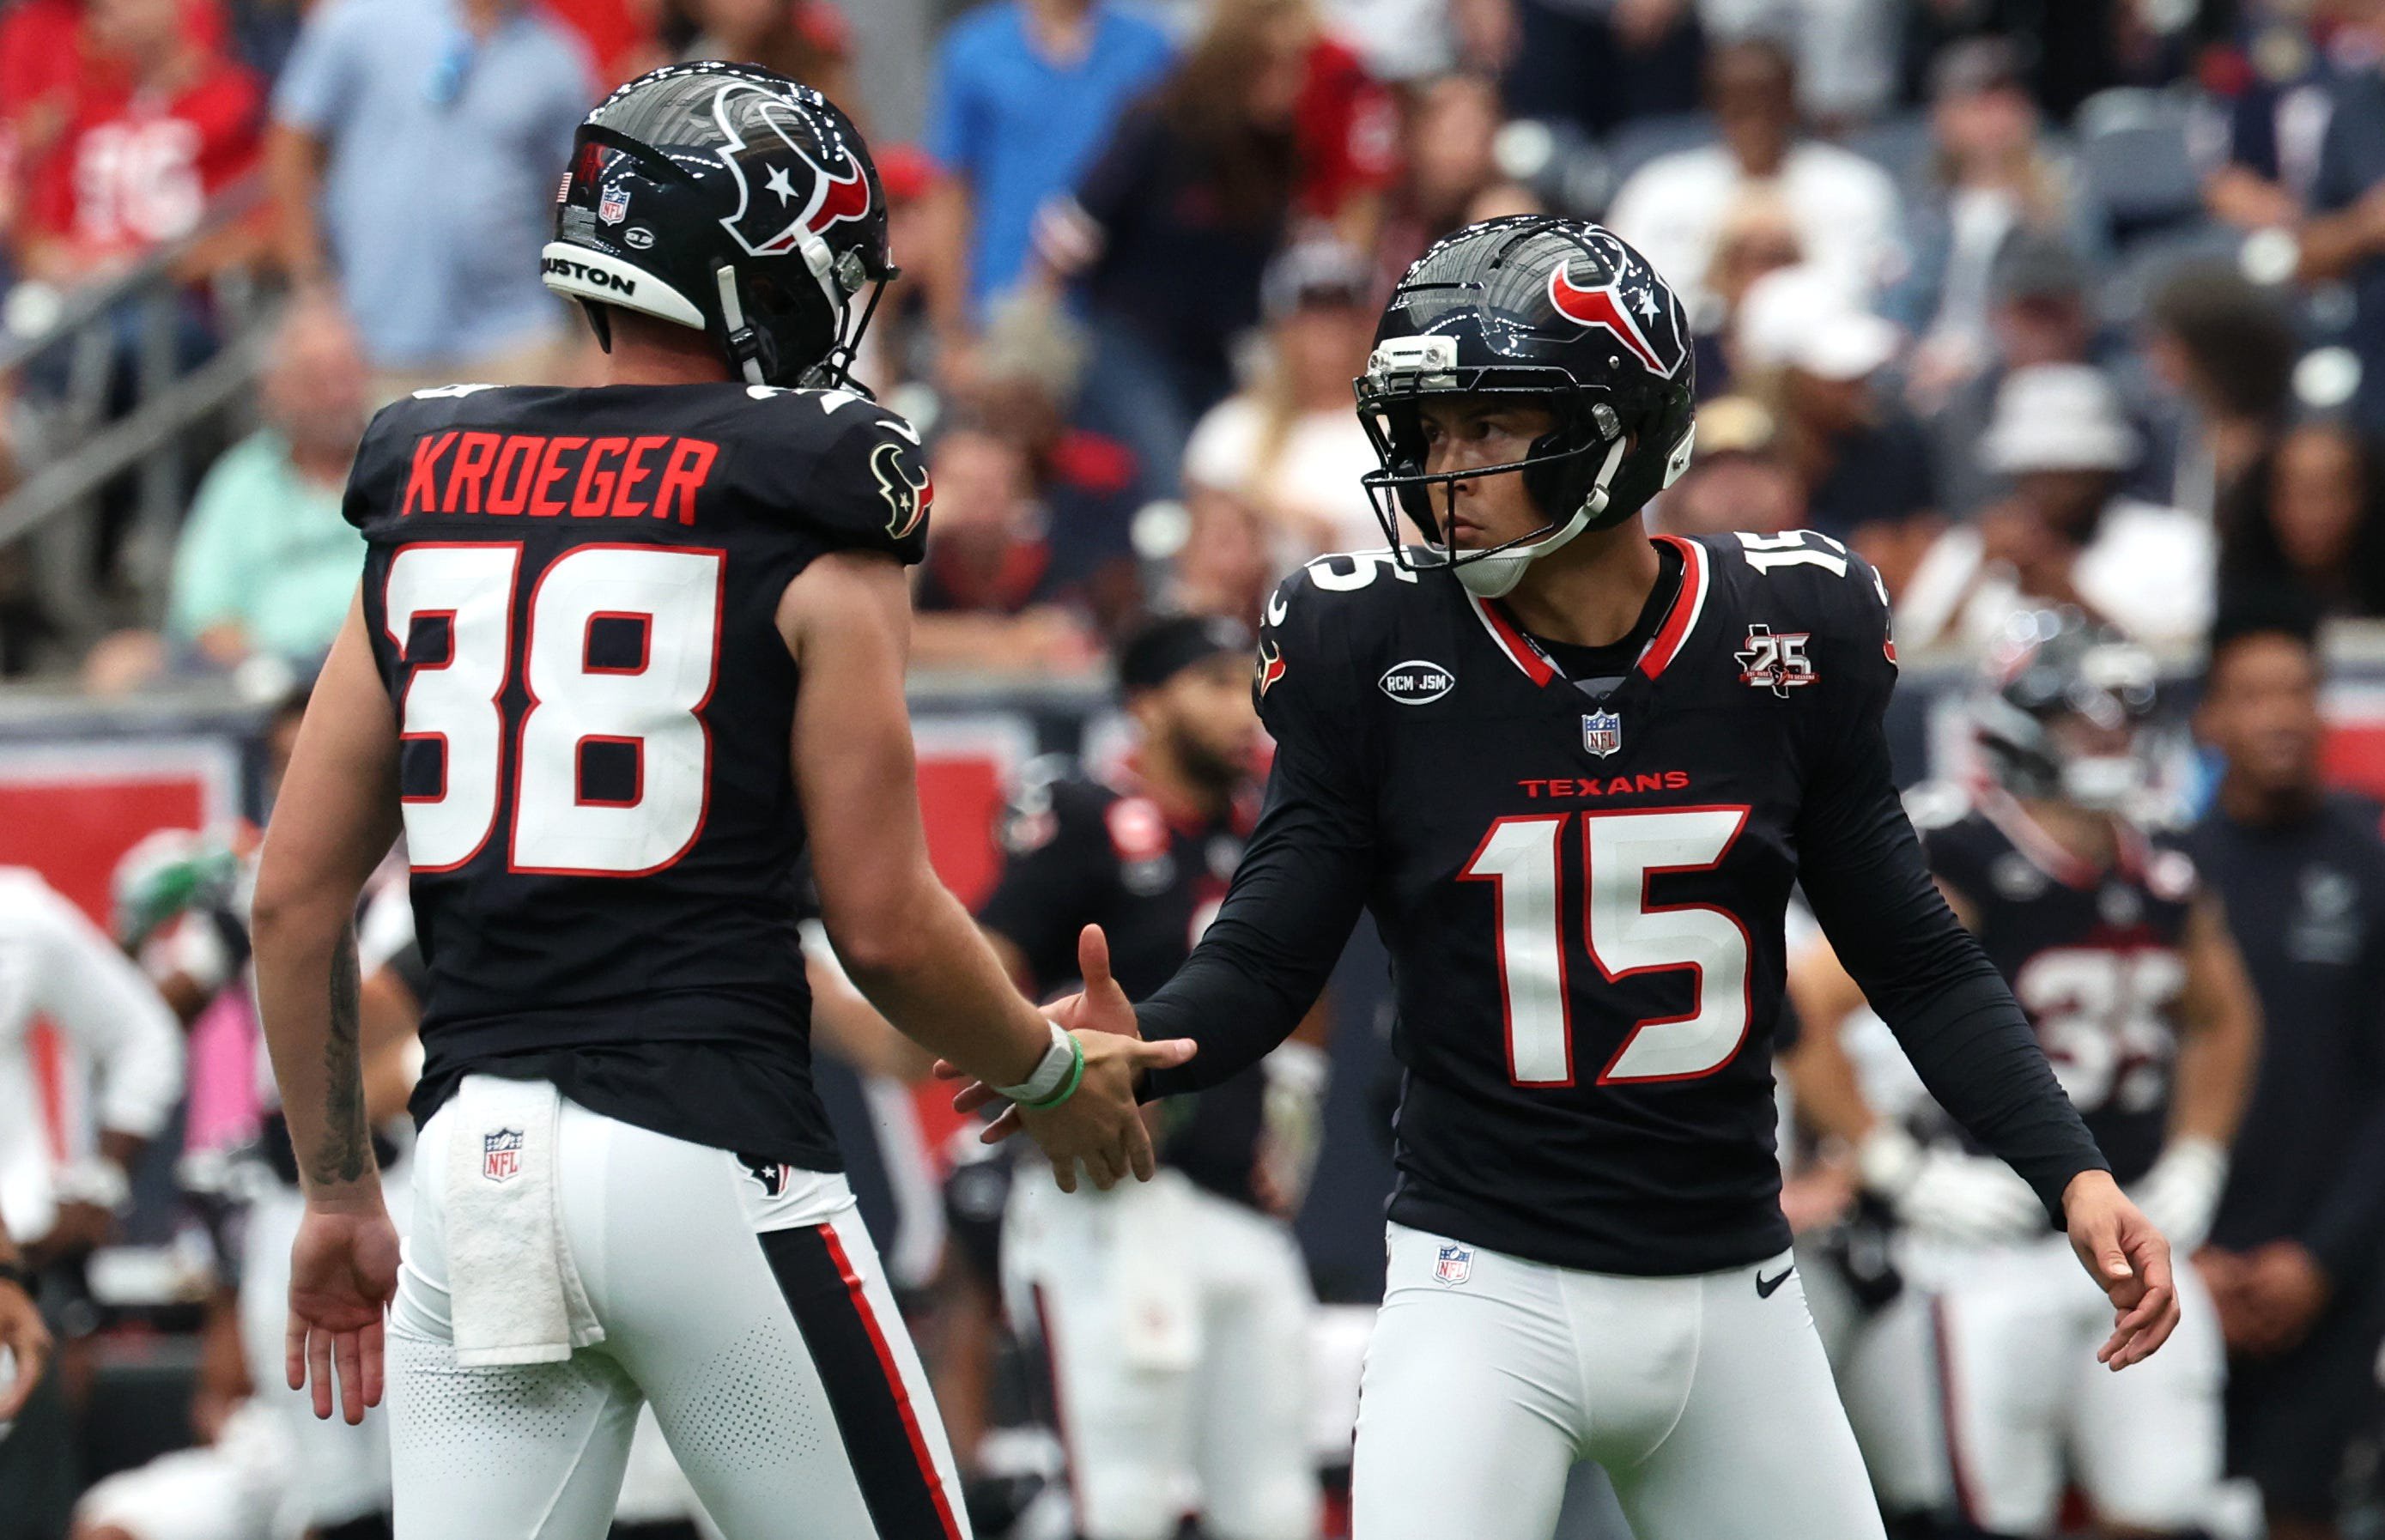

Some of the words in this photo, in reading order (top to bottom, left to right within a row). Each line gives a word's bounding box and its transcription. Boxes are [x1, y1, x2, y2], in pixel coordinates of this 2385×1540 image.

[603, 203, 622, 218] NFL
[402, 430, 719, 526] KROEGER
[1747, 634, 1811, 686] 25
[1387, 675, 1414, 692] RCM
[1418, 674, 1447, 690] JSM
[384, 541, 727, 878] 38
[1589, 731, 1616, 750] NFL
[1517, 771, 1690, 799] TEXANS
[1456, 804, 1752, 1088] 15
[487, 1151, 518, 1177] NFL
[1438, 1261, 1464, 1279] NFL
